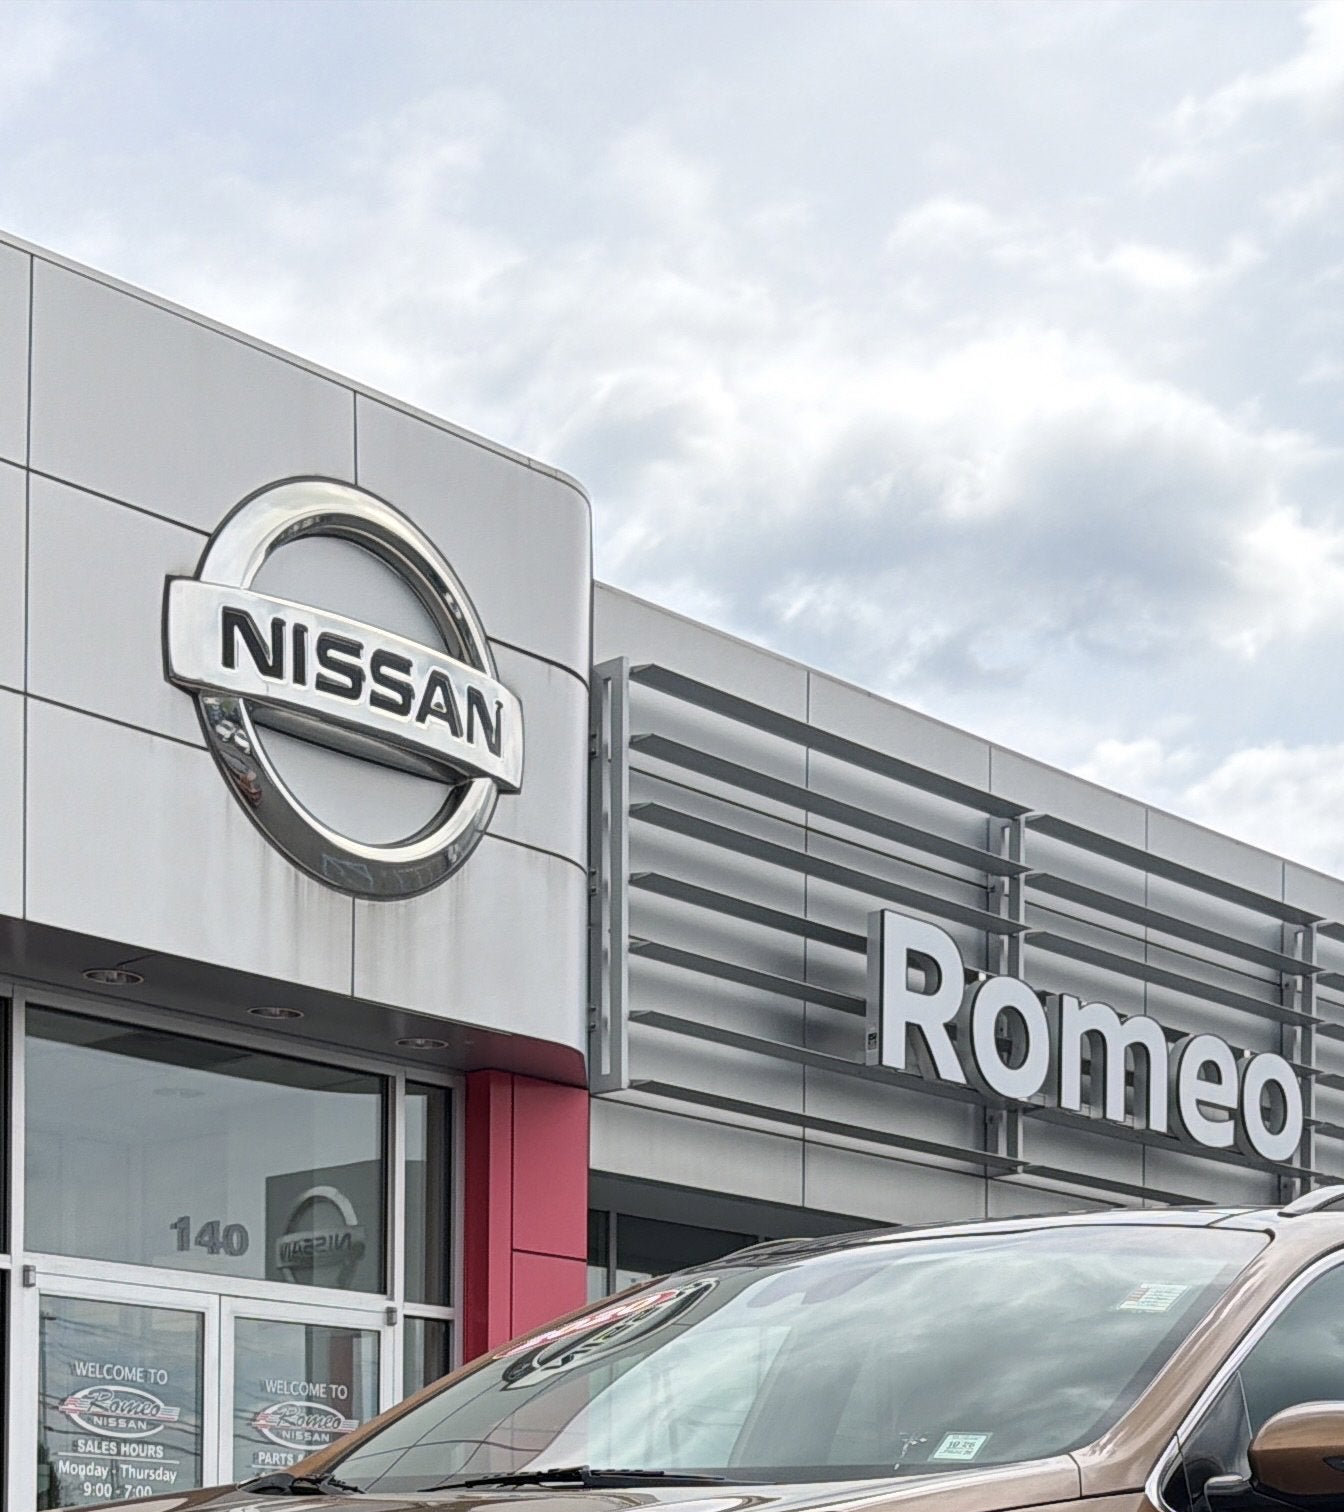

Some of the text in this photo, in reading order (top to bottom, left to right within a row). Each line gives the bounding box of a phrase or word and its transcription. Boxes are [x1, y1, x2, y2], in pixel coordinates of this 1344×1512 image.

[221, 605, 503, 759] NISSAN
[876, 908, 1304, 1163] Romeo
[170, 1215, 249, 1257] 140
[75, 1360, 168, 1385] WELCOME TO
[265, 1379, 348, 1400] WELCOME TO
[82, 1388, 161, 1417] Romeo
[92, 1416, 147, 1430] NISSAN
[276, 1405, 341, 1430] Romeo
[282, 1430, 330, 1442] NISSAN
[77, 1440, 164, 1458] SALES HOURS
[258, 1451, 294, 1466] PARTS
[58, 1460, 109, 1479] Monday
[120, 1464, 177, 1485] Thursday
[84, 1482, 112, 1497] 9:00
[125, 1484, 152, 1499] 7:00
